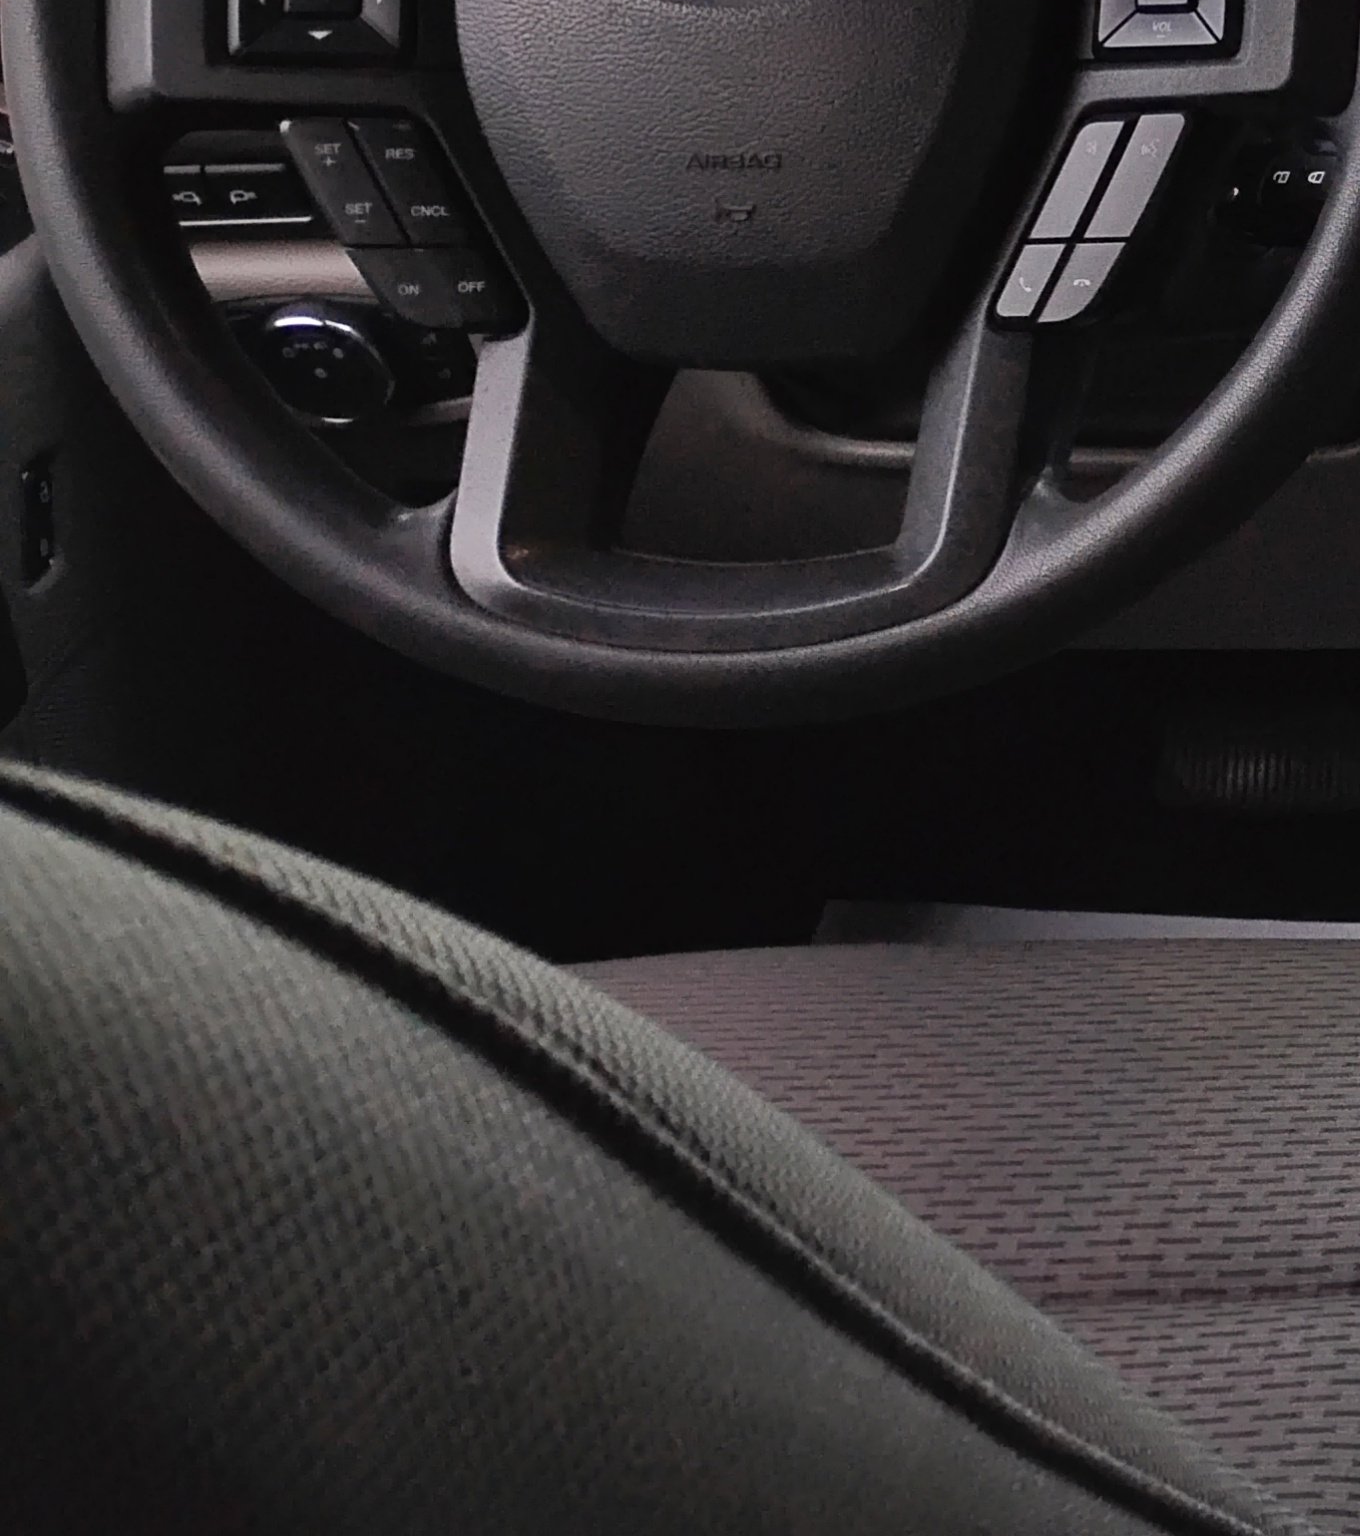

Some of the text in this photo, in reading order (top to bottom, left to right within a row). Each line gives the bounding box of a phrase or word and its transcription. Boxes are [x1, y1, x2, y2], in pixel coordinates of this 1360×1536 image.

[1151, 21, 1173, 33] VOL
[314, 142, 342, 155] SET
[384, 148, 416, 161] RES
[685, 153, 783, 170] AIRBAG
[345, 202, 373, 215] SET
[410, 204, 449, 218] CNCL
[397, 283, 420, 296] ON
[457, 280, 486, 294] OFF
